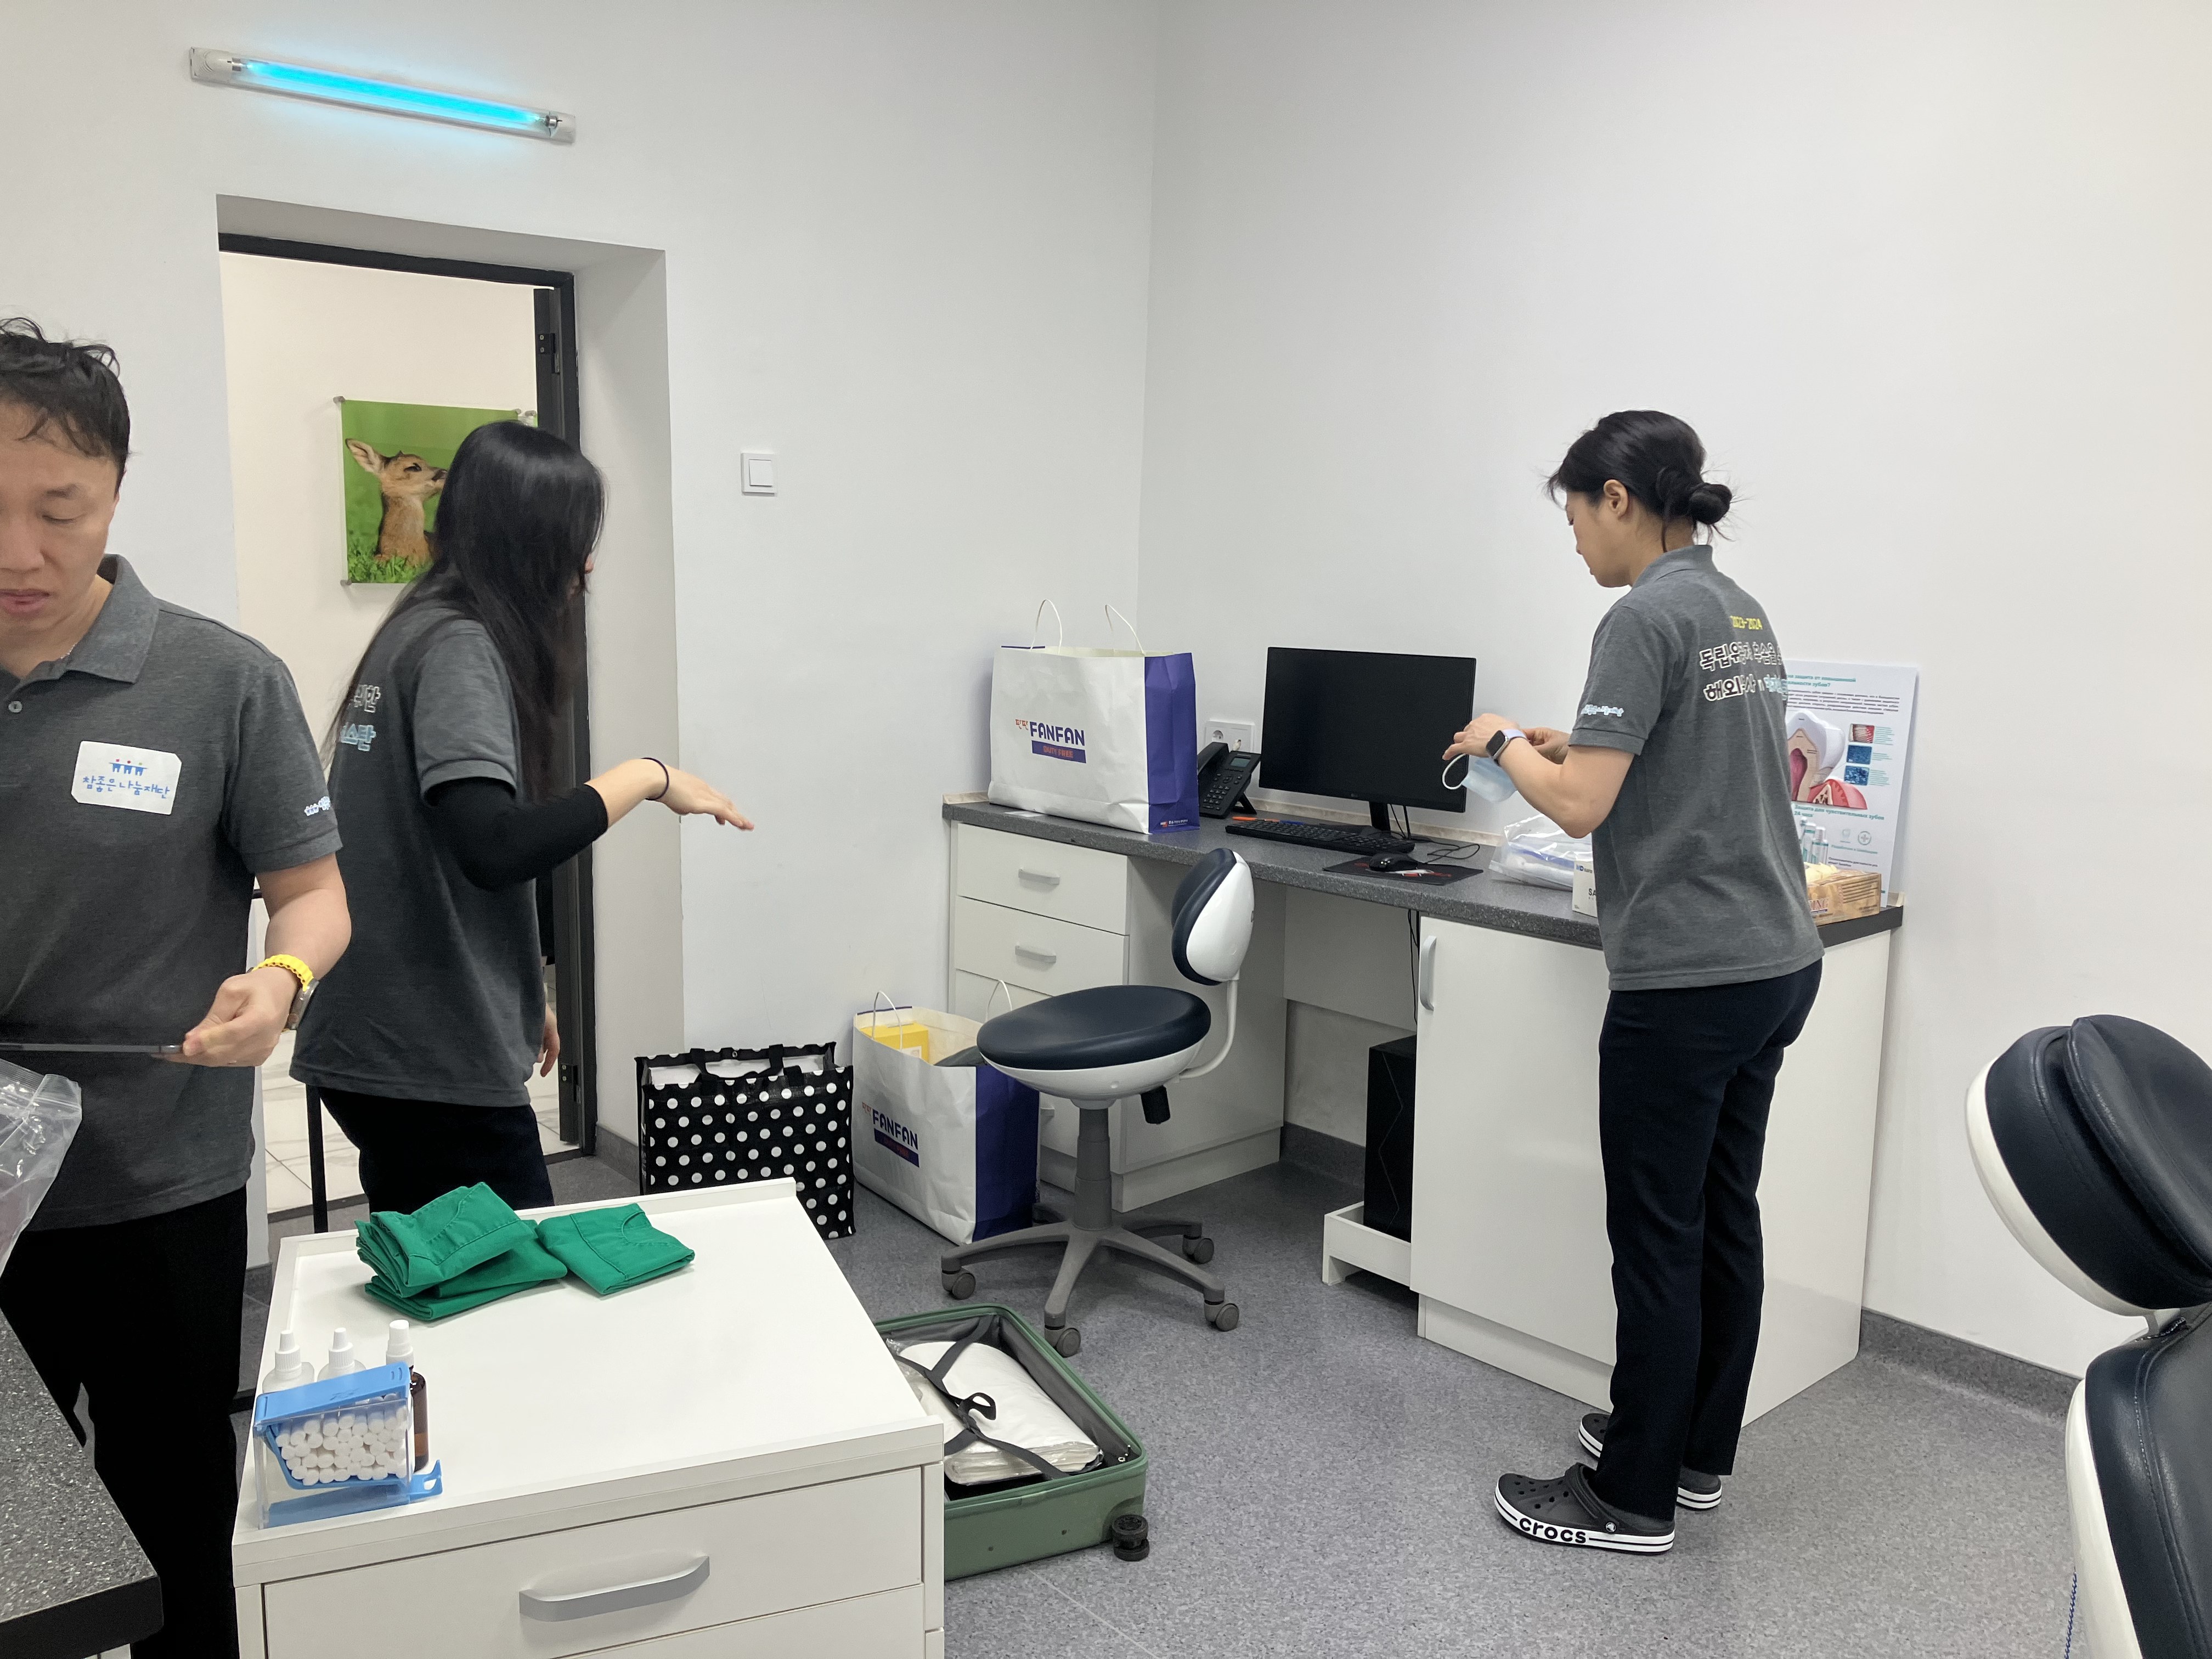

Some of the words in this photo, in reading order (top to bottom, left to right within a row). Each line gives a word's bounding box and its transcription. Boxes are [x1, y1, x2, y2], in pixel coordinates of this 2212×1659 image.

[1029, 721, 1085, 746] FANFAN
[872, 1108, 918, 1150] FANFAN
[1519, 1518, 1587, 1544] crocs
